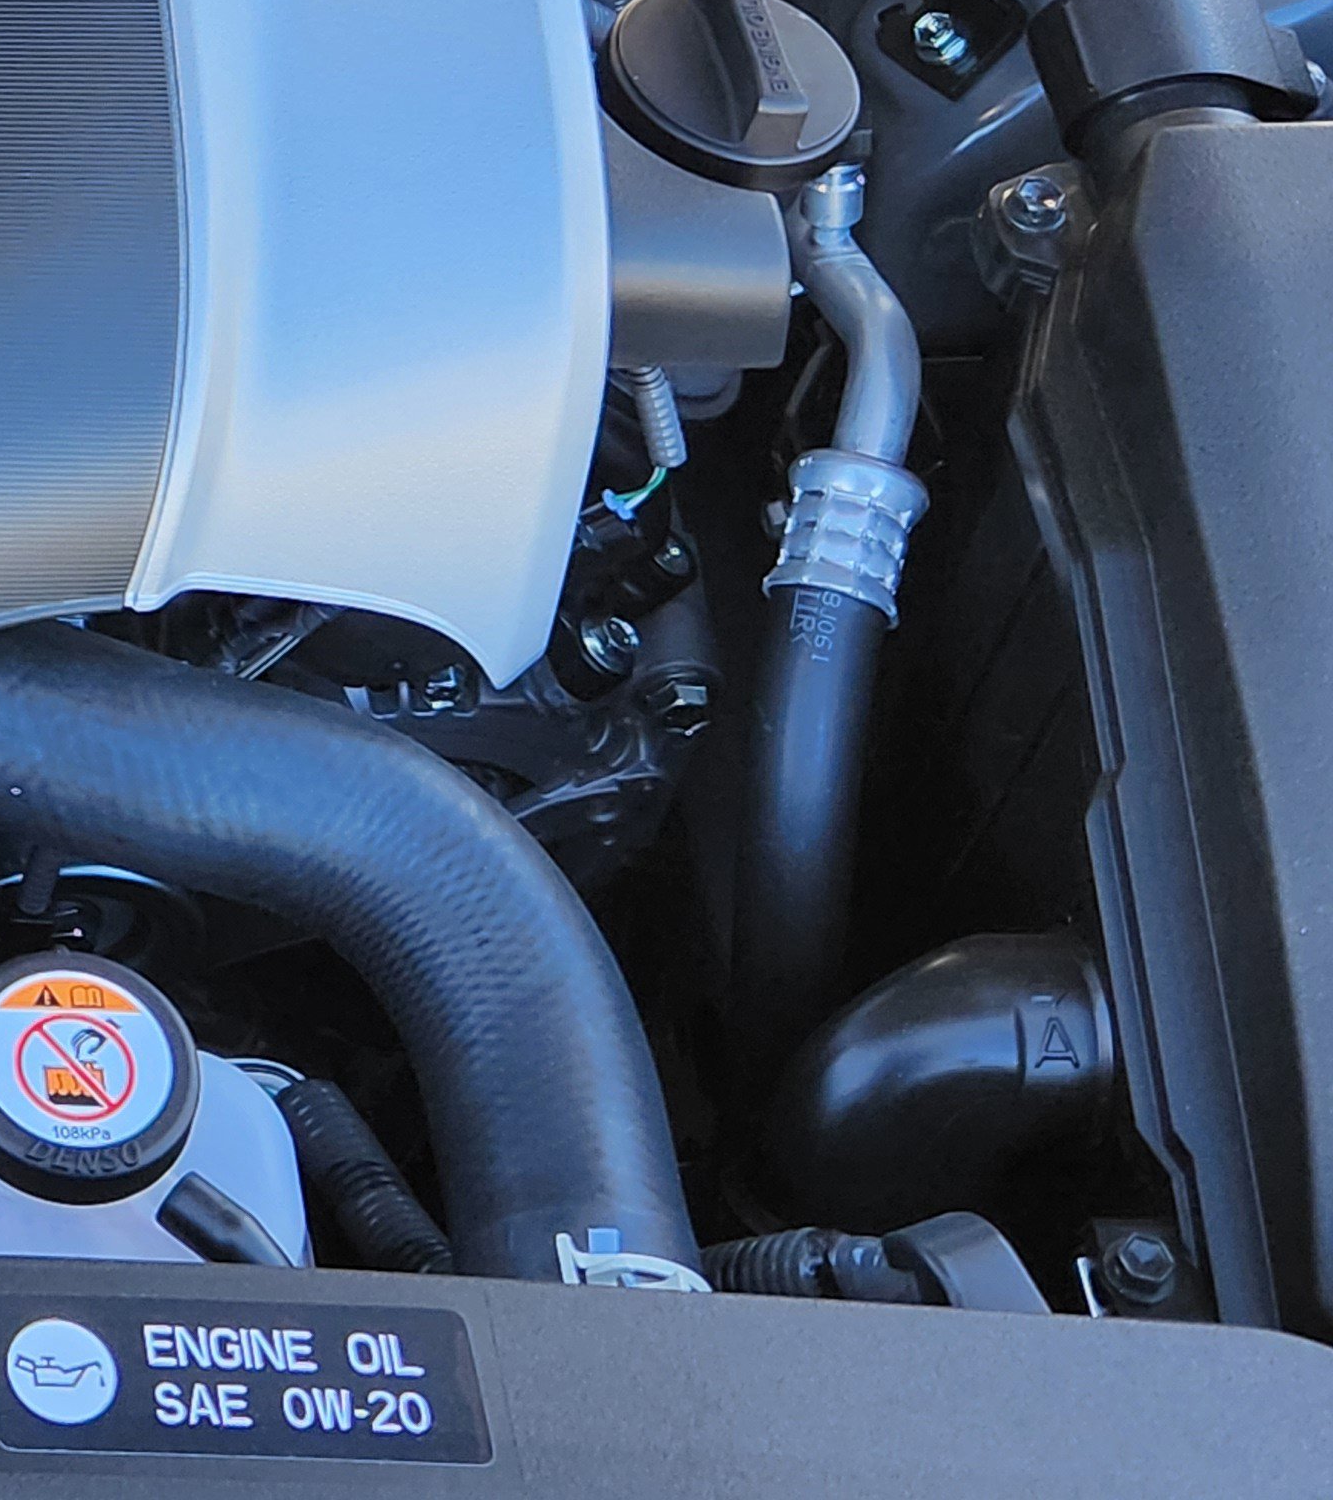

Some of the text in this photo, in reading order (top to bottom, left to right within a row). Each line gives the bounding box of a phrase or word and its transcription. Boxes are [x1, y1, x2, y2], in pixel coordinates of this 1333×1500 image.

[1034, 1016, 1081, 1069] A
[24, 1139, 142, 1175] DENSO
[52, 1125, 112, 1141] 108kPa
[143, 1324, 426, 1378] ENGINE OIL
[153, 1381, 433, 1435] SAE 0W-20
